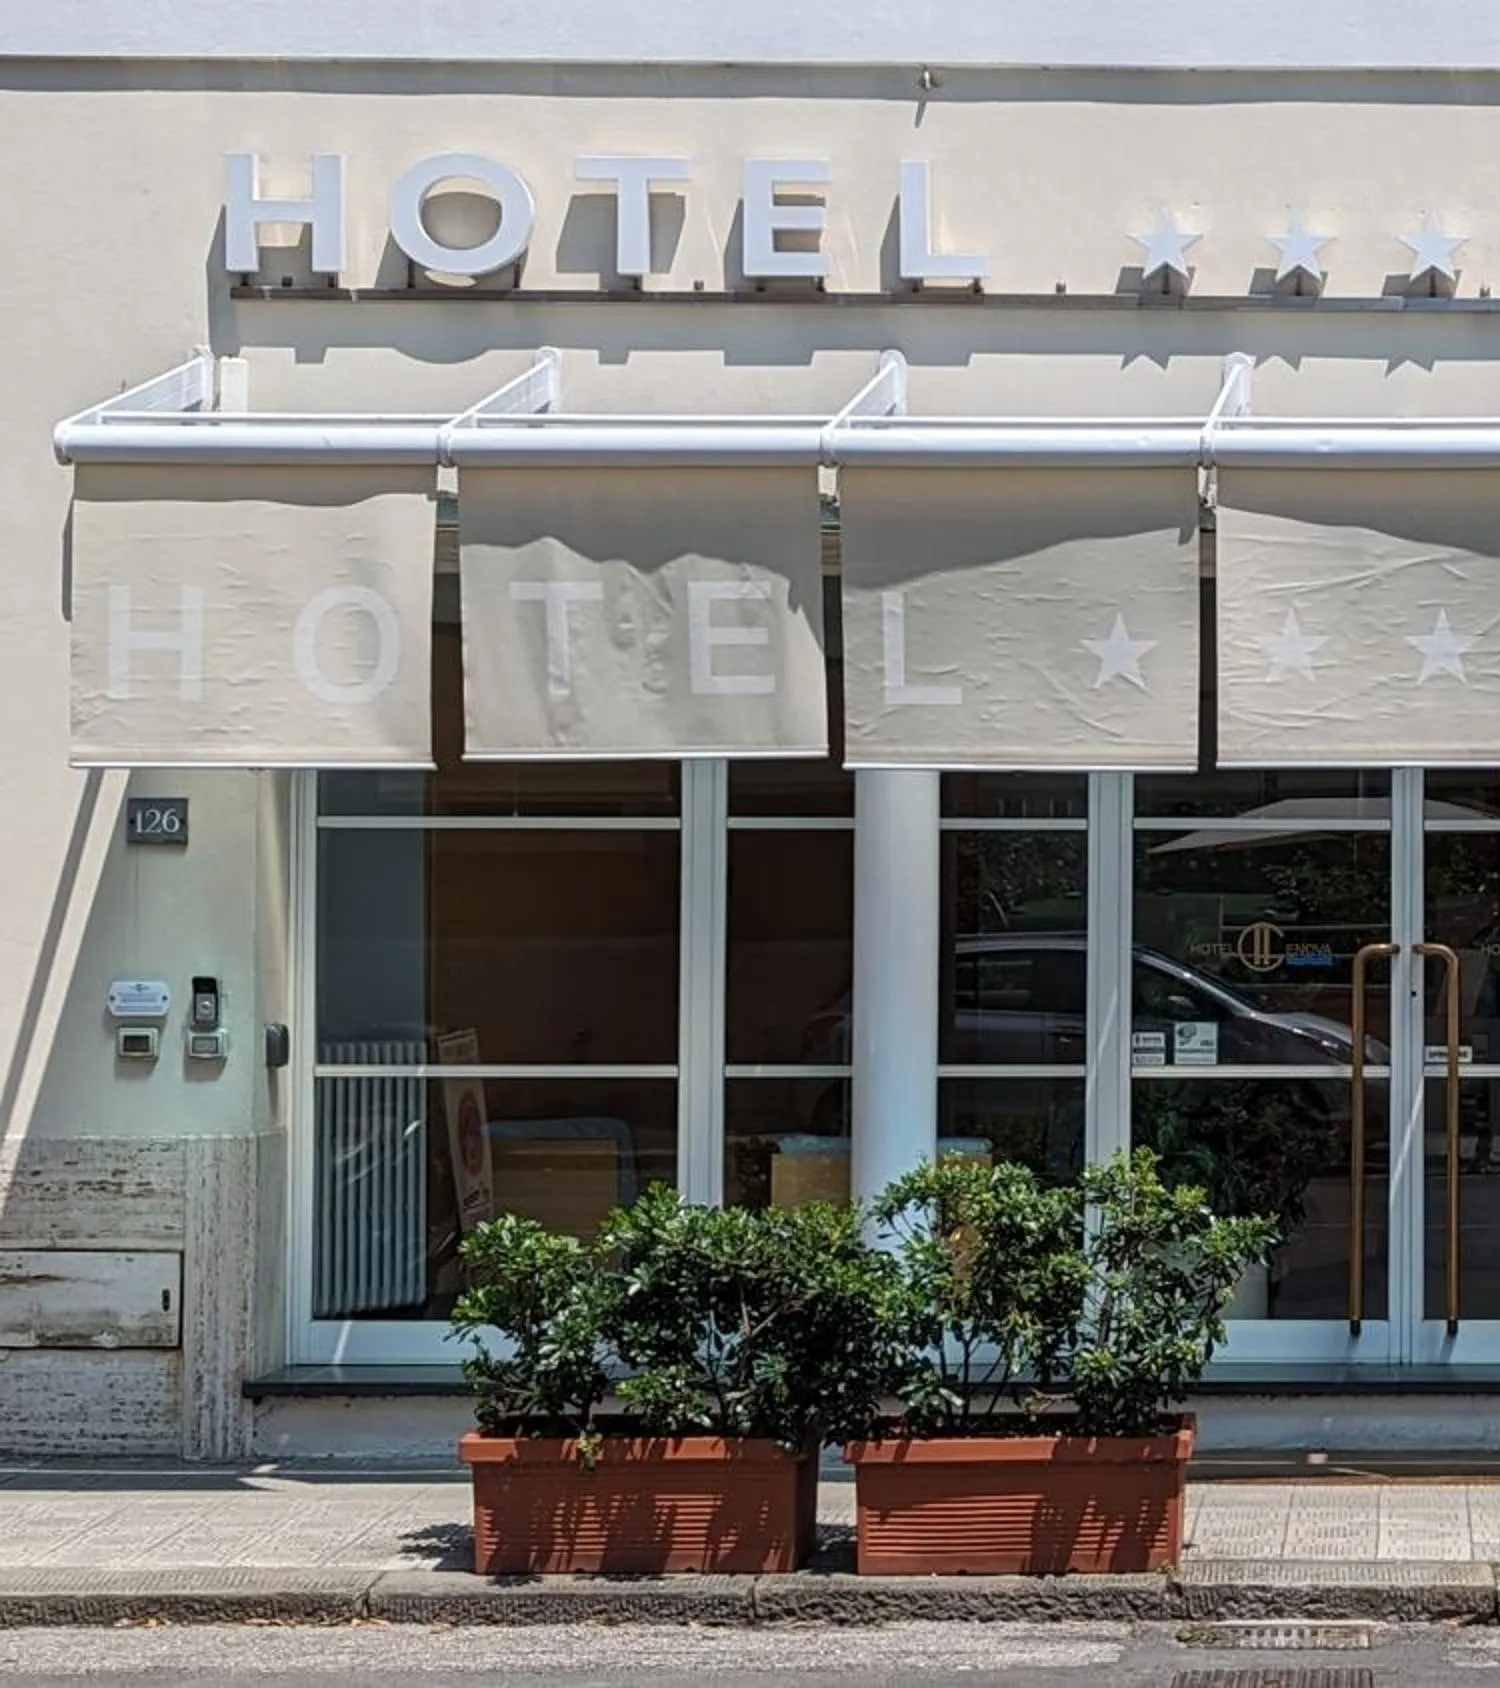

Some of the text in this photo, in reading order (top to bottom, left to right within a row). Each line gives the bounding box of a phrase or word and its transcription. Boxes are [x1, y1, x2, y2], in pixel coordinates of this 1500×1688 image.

[223, 149, 990, 278] HOTEL
[106, 580, 962, 707] HOTEL
[135, 808, 181, 833] 126
